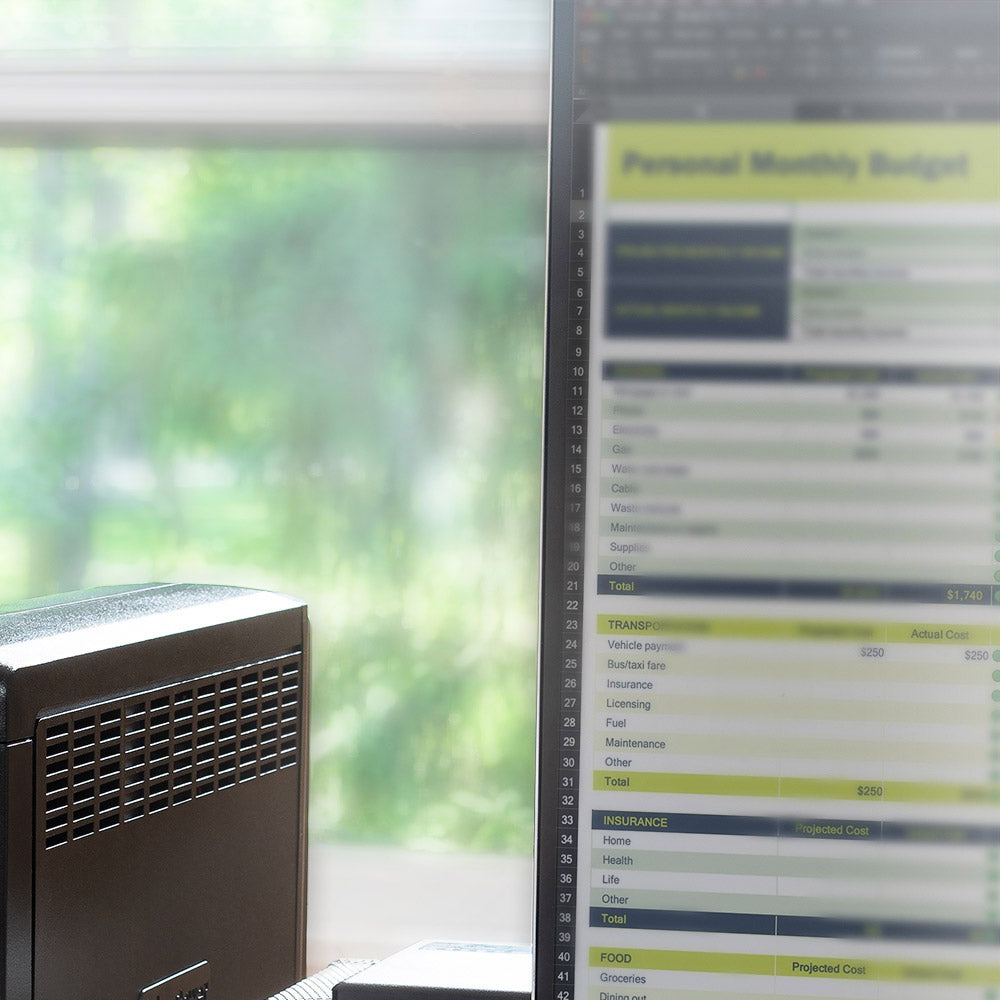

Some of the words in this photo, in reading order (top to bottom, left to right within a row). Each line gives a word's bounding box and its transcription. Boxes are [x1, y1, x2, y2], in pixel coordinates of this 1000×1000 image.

[621, 151, 740, 177] Personal
[750, 151, 858, 179] Monthly
[869, 152, 968, 180] Budget
[580, 188, 584, 198] 1
[578, 210, 585, 220] 2
[578, 230, 585, 239] 3
[577, 248, 584, 258] 4
[577, 268, 584, 277] 5
[577, 288, 583, 297] 6
[577, 306, 583, 316] 7
[576, 326, 582, 335] 8
[575, 348, 582, 357] 9
[573, 367, 584, 376] 10
[572, 386, 583, 395] 11
[572, 406, 583, 415] 12
[571, 425, 583, 435] 13
[571, 445, 582, 454] 14
[571, 464, 581, 474] 15
[570, 484, 581, 493] 16
[568, 562, 579, 571] 20
[610, 562, 636, 571] Other
[567, 581, 578, 590] 21
[609, 581, 634, 591] Total
[947, 589, 983, 601] $1,740
[566, 601, 578, 610] 22
[566, 620, 578, 630] 23
[911, 628, 943, 640] Actual
[946, 629, 969, 640] Cost
[566, 640, 577, 649] 24
[608, 640, 642, 650] Vehicle
[860, 647, 884, 658] $250
[964, 650, 989, 661] $250
[565, 659, 577, 668] 25
[608, 660, 644, 670] Bus/taxi
[647, 660, 666, 670] fare
[565, 679, 577, 688] 26
[607, 680, 653, 690] Insurance
[564, 698, 576, 707] 27
[606, 699, 651, 711] Licensing
[564, 718, 576, 727] 28
[606, 718, 626, 727] Fuel
[563, 737, 576, 746] 29
[606, 738, 666, 749] Maintenance
[563, 758, 575, 767] 30
[605, 757, 632, 767] Other
[562, 777, 574, 786] 31
[604, 776, 630, 786] Total
[858, 786, 883, 796] $250
[562, 796, 574, 805] 32
[561, 816, 573, 824] 33
[604, 816, 668, 827] INSURANCE
[796, 824, 842, 836] Projected
[846, 826, 869, 836] Cost
[561, 835, 573, 844] 34
[603, 836, 631, 846] Home
[561, 855, 572, 864] 35
[602, 856, 633, 865] Health
[560, 874, 572, 883] 36
[602, 875, 620, 885] Life
[560, 894, 572, 903] 37
[602, 894, 628, 904] Other
[559, 913, 571, 922] 38
[601, 913, 627, 924] Total
[559, 933, 571, 942] 39
[558, 952, 570, 961] 40
[600, 953, 632, 963] FOOD
[792, 962, 840, 974] Projected
[843, 964, 866, 974] Cost
[558, 972, 569, 981] 41
[600, 973, 646, 984] Groceries
[557, 991, 569, 1000] 42
